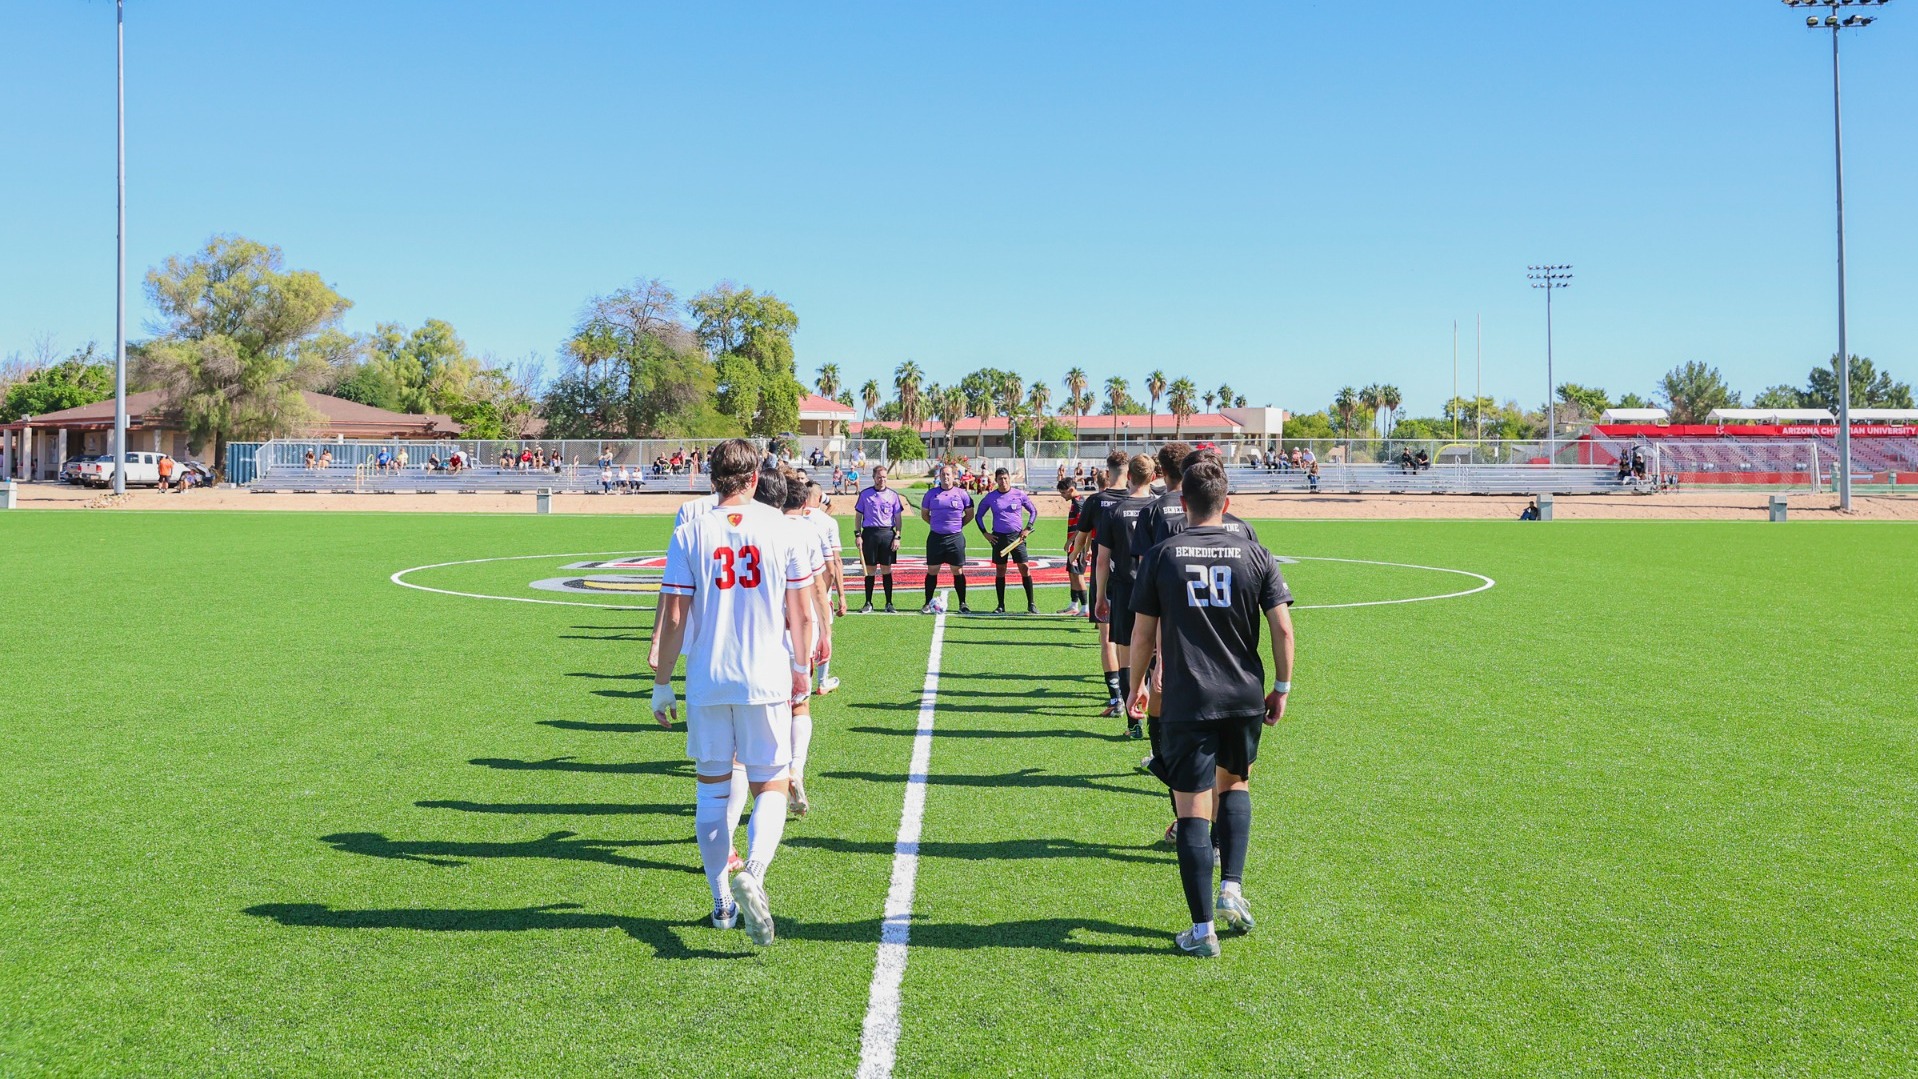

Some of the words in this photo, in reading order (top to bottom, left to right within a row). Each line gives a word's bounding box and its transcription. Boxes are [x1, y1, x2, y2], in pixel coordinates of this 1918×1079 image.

[1782, 427, 1819, 435] ARIZONA
[1820, 427, 1865, 435] CHRIIAN
[1867, 427, 1916, 435] UNIVERSITY
[1175, 546, 1241, 559] BENEDICTINE
[713, 545, 761, 590] 33
[1185, 564, 1232, 607] 28
